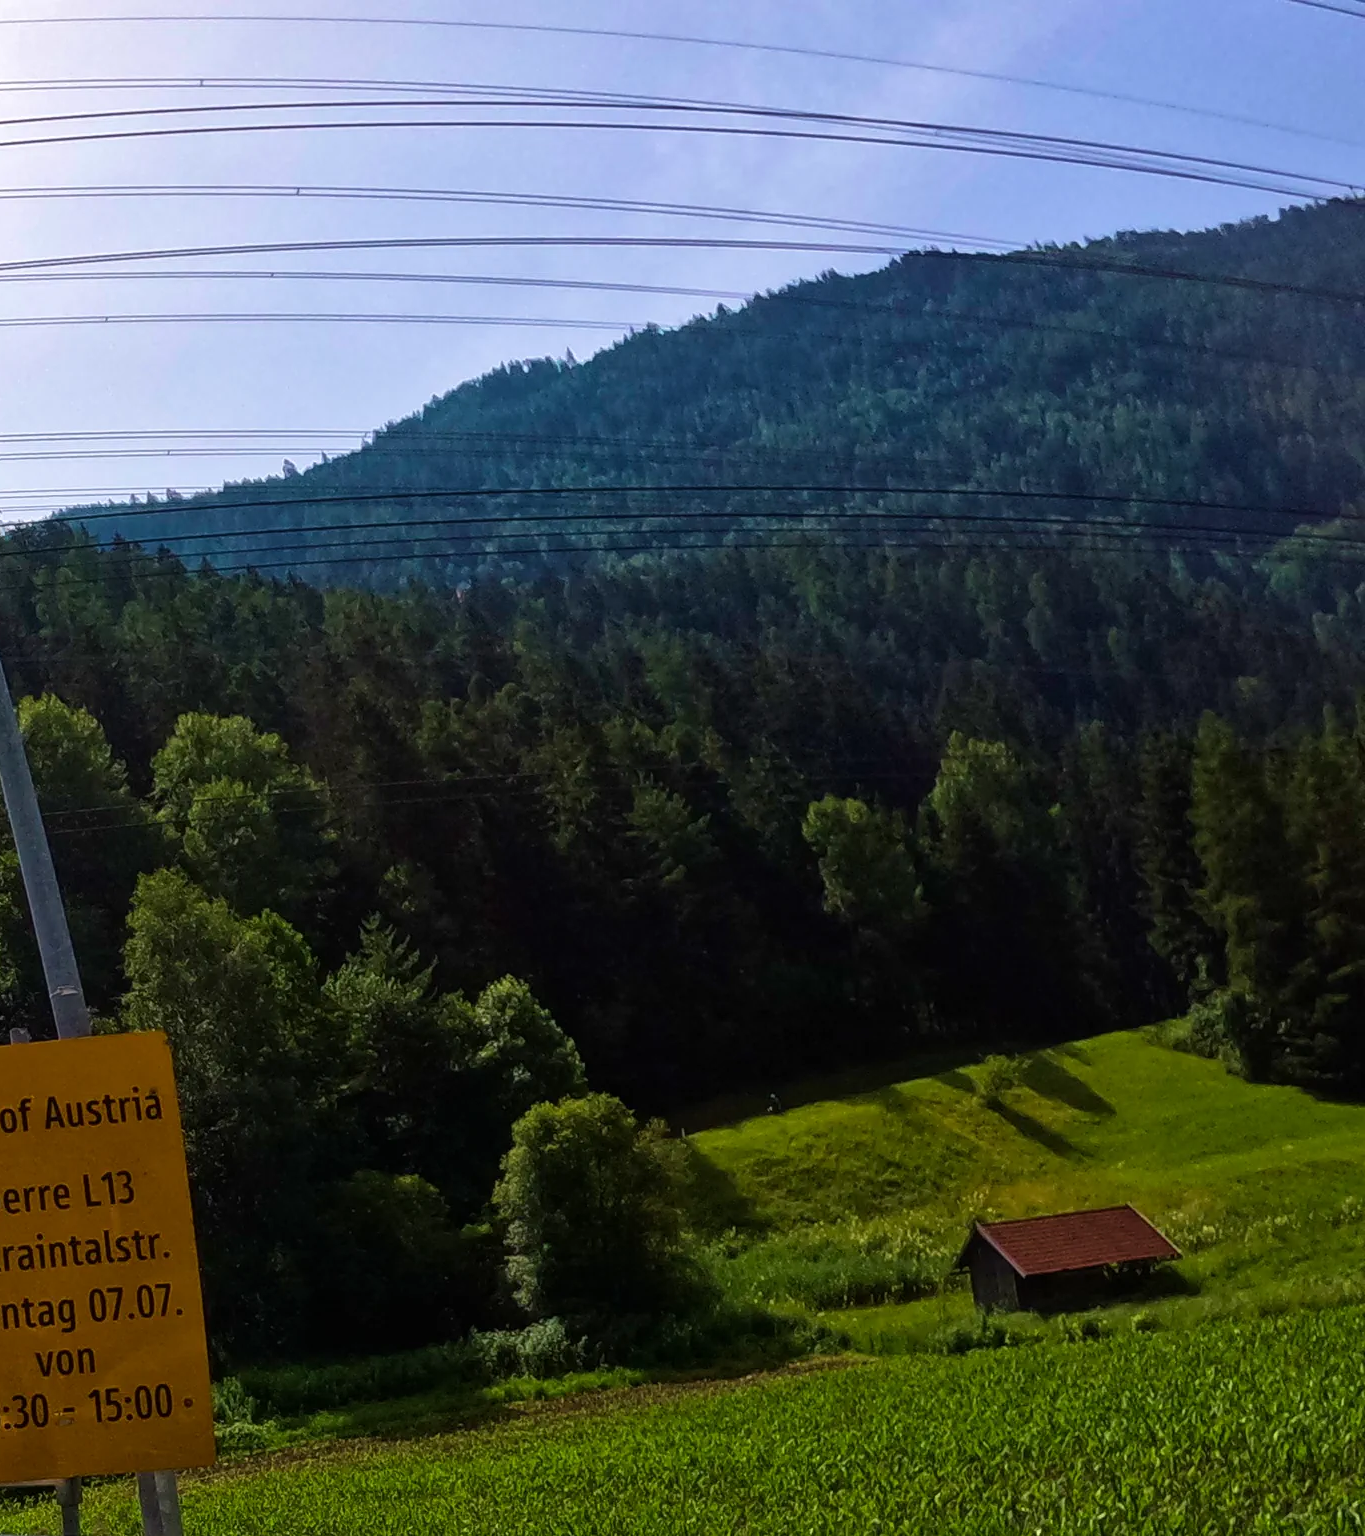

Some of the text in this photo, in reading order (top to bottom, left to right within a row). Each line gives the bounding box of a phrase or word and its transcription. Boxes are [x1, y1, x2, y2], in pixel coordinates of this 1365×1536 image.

[0, 1097, 32, 1134] of
[44, 1087, 163, 1130] Austria
[82, 1169, 136, 1208] L13
[88, 1282, 184, 1322] 07.07.
[33, 1347, 96, 1378] von
[87, 1382, 174, 1424] 15:00
